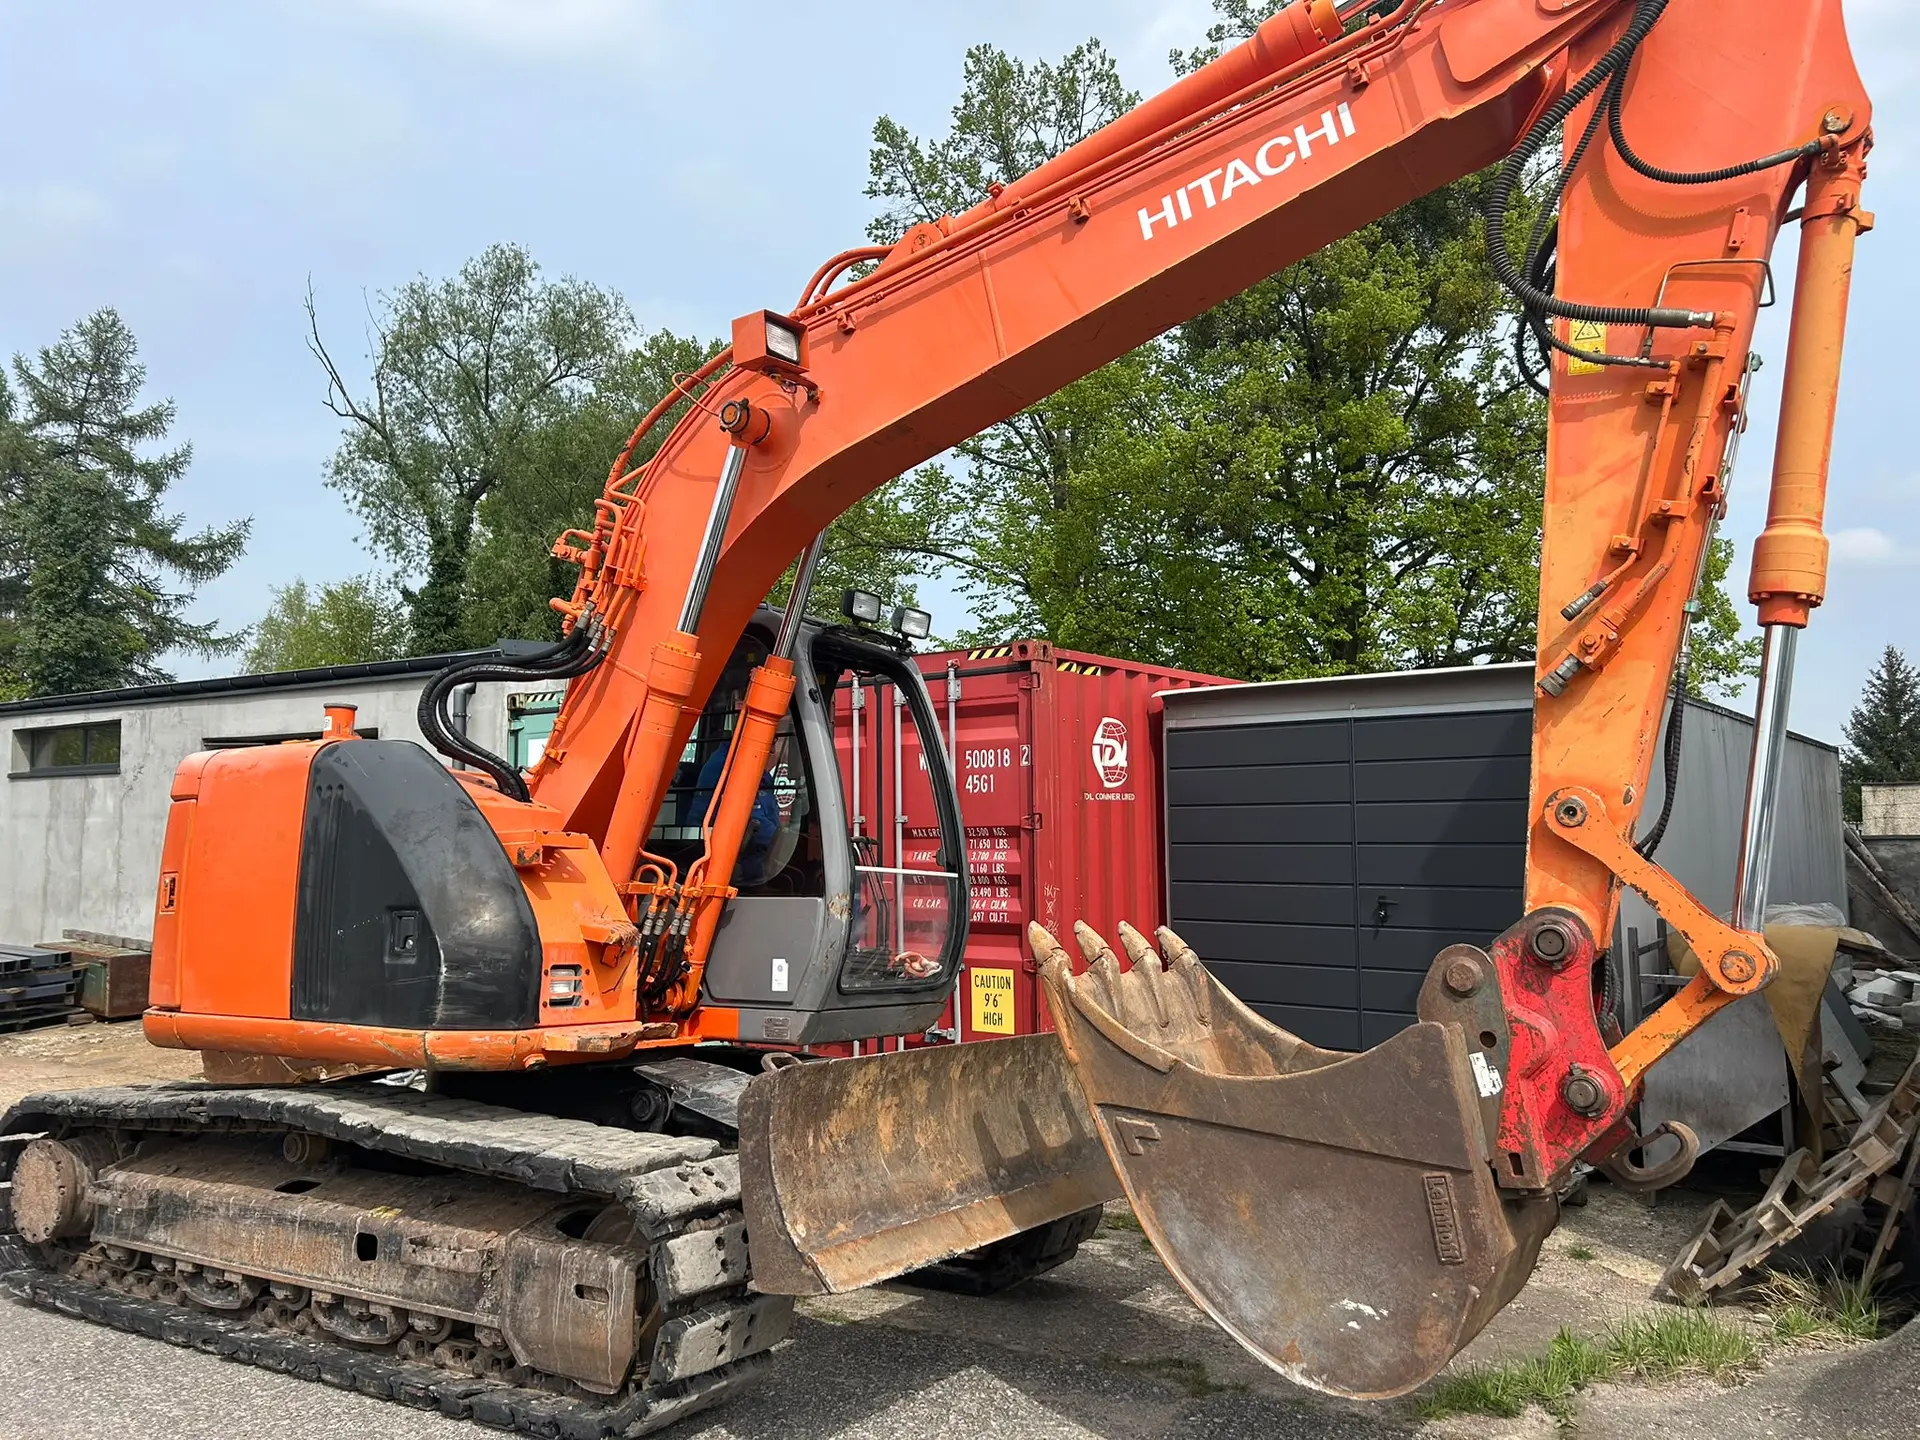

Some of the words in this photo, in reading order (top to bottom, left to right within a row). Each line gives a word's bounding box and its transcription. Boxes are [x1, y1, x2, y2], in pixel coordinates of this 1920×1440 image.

[1137, 101, 1357, 241] HITACHI
[965, 748, 1011, 769] 500818
[1021, 746, 1029, 766] 2
[965, 773, 995, 793] 45G1
[969, 839, 991, 849] 71.650
[995, 838, 1011, 849] LBS.
[912, 851, 931, 861] TARE
[992, 863, 1008, 874] LBS.
[970, 887, 992, 897] 63.490
[996, 887, 1012, 898] LBS.
[971, 899, 987, 910] 76.4
[974, 974, 1011, 990] CAUTION
[983, 1011, 1003, 1027] HIGH
